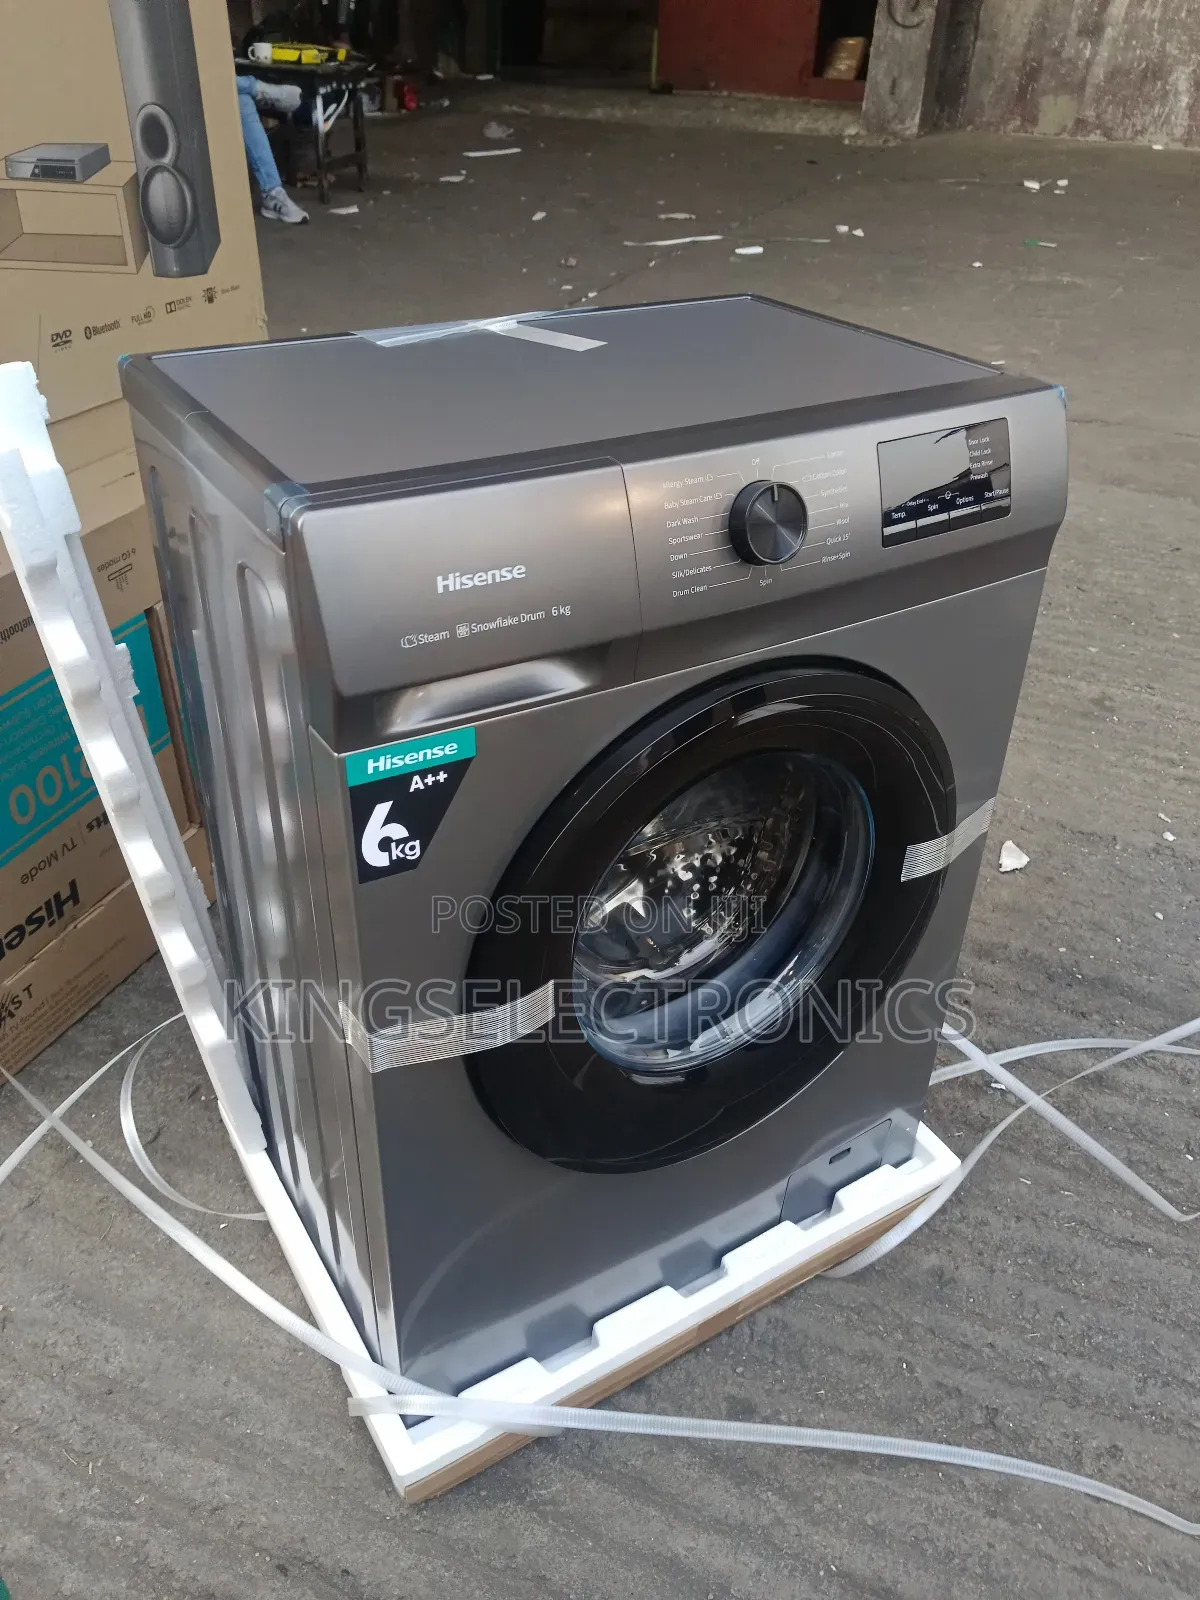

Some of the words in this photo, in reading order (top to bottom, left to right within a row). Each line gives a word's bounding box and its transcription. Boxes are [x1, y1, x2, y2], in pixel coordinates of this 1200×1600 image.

[92, 320, 120, 336] Bluetooth
[51, 329, 72, 342] DVD
[685, 476, 704, 486] Steam
[664, 500, 679, 509] Baby
[681, 497, 698, 507] Steam
[699, 495, 713, 503] Care
[927, 503, 939, 512] Spin
[956, 496, 975, 506] Options
[666, 519, 681, 528] Dark
[682, 515, 699, 525] Wash
[836, 516, 850, 526] Wool
[668, 533, 703, 545] Sportswear
[826, 534, 842, 546] Quick
[670, 553, 688, 562] Down
[821, 551, 851, 563] Rinse+Spin
[97, 556, 121, 573] modes
[436, 564, 526, 593] Hisense
[671, 565, 712, 579] Silk/Delicates
[759, 577, 773, 587] Spin
[672, 589, 690, 598] Drum
[690, 585, 708, 594] Clean
[0, 616, 35, 643] uetooth
[418, 630, 450, 645] Steam
[471, 615, 519, 634] Snowflake
[520, 610, 546, 623] Drum
[551, 606, 558, 617] 6
[559, 604, 571, 617] kg
[367, 742, 459, 775] Hisense
[409, 770, 448, 793] A++
[61, 836, 78, 857] TV
[20, 849, 59, 885] Mode
